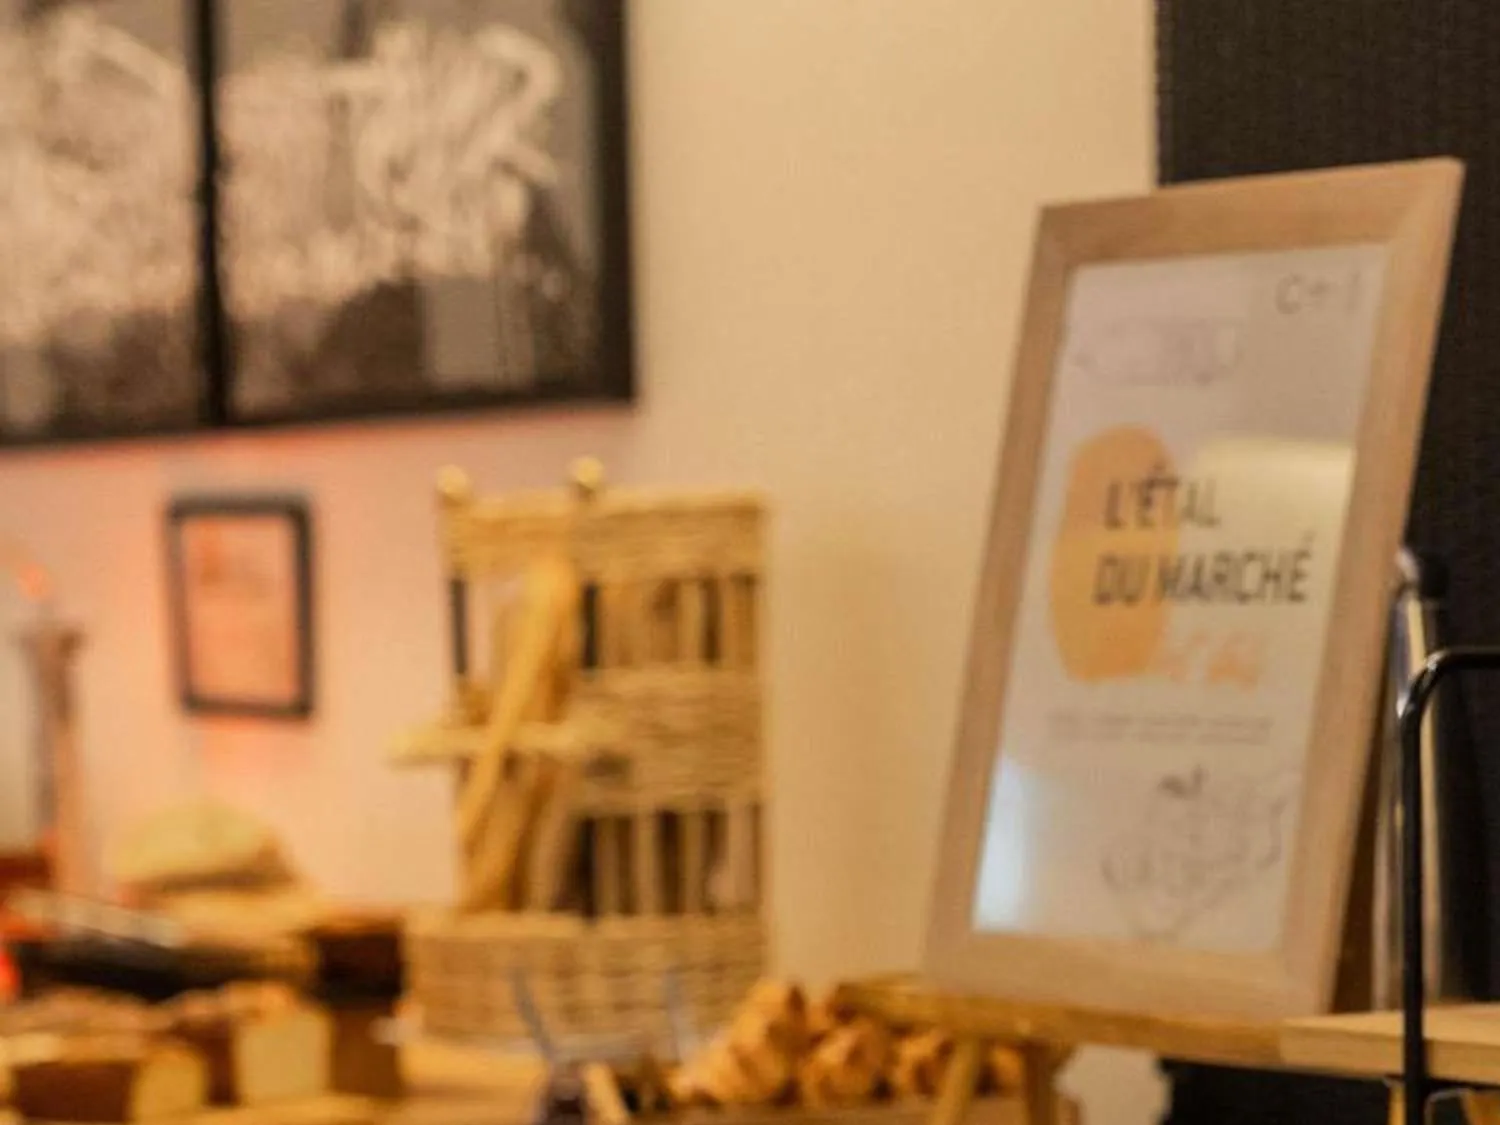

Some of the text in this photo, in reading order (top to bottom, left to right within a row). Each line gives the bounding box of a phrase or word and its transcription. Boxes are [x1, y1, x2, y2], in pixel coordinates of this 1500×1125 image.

[1105, 462, 1222, 529] L'ÉTAL
[1092, 531, 1314, 606] DU MARCHÉ
